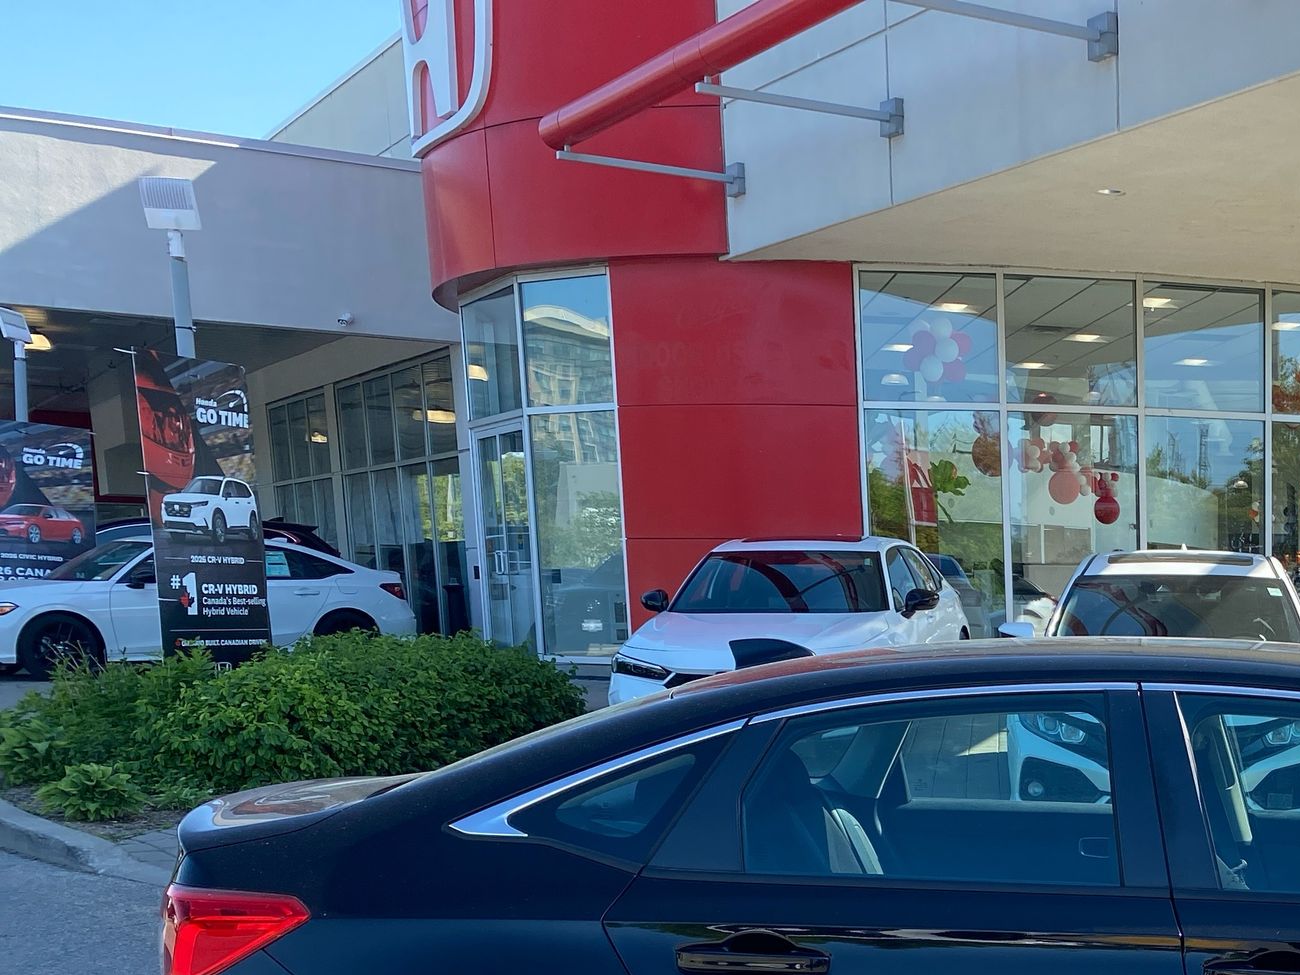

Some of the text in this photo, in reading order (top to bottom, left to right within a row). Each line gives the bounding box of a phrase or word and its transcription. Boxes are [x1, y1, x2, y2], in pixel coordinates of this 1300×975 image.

[195, 397, 218, 407] Honda
[196, 408, 249, 428] GO TIME
[22, 453, 82, 469] GO TIME
[207, 556, 222, 564] CR-V
[223, 557, 245, 565] HYBRID
[202, 583, 258, 595] CR-V HYBRID
[202, 596, 266, 607] Canada's Best-selling
[202, 607, 226, 617] Hybrid
